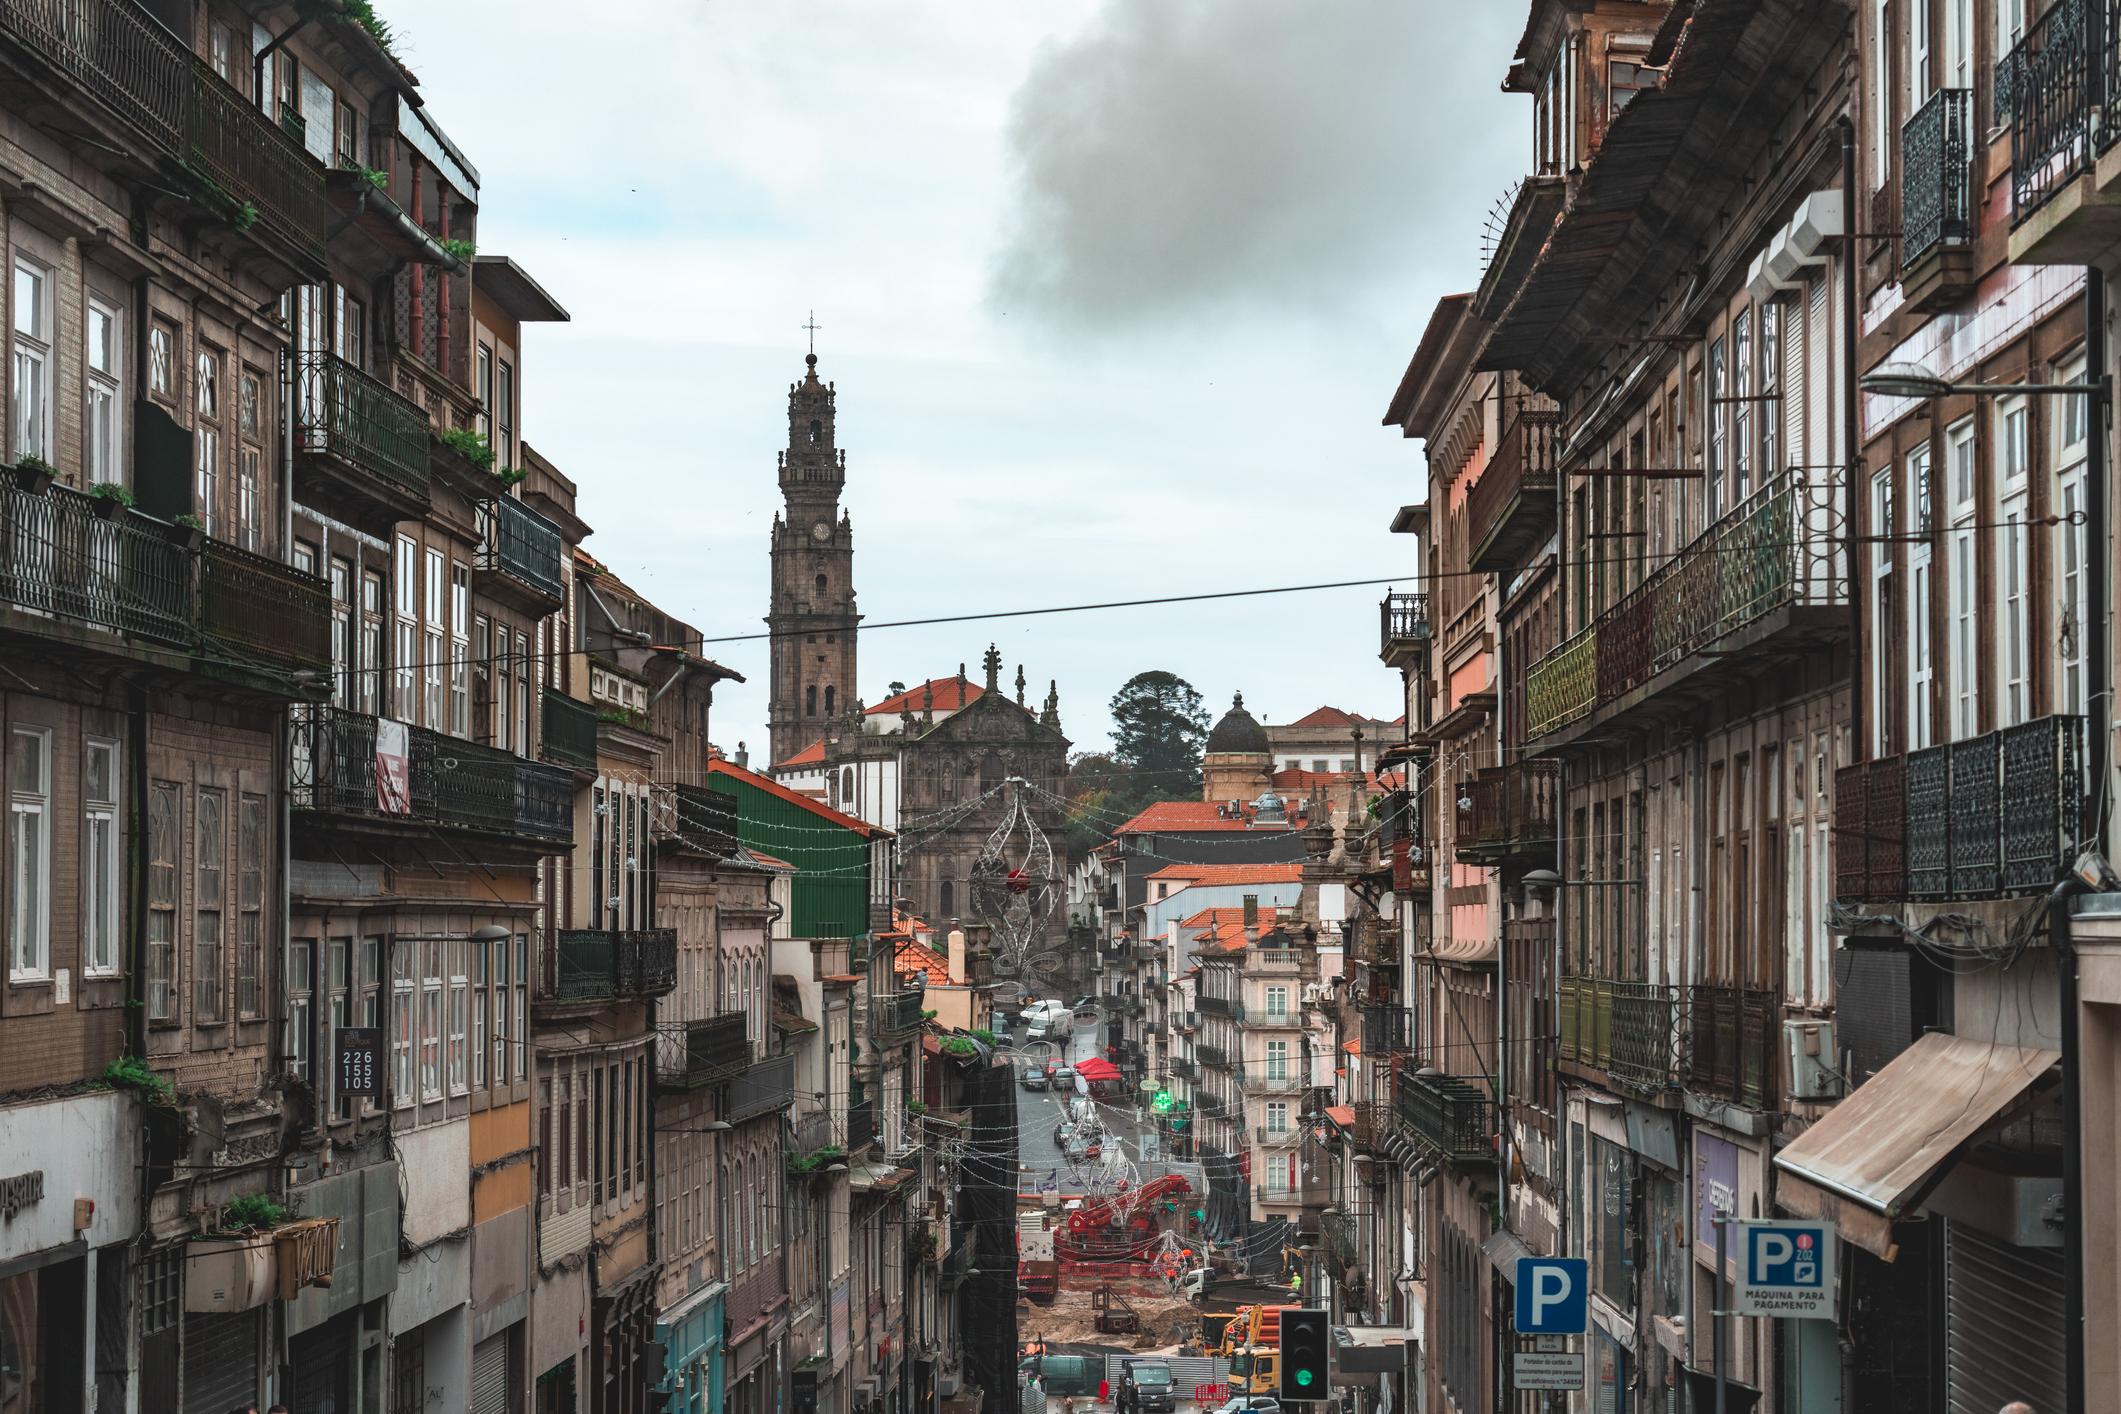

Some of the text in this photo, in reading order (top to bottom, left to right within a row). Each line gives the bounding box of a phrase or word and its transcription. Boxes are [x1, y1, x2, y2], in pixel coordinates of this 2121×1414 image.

[343, 1051, 372, 1064] 226
[344, 1065, 372, 1077] 155
[344, 1077, 372, 1089] 105
[1757, 1233, 1793, 1281] P
[1531, 1266, 1572, 1326] P
[1798, 1291, 1825, 1300] PARA
[1753, 1300, 1817, 1311] PAGAMENTO
